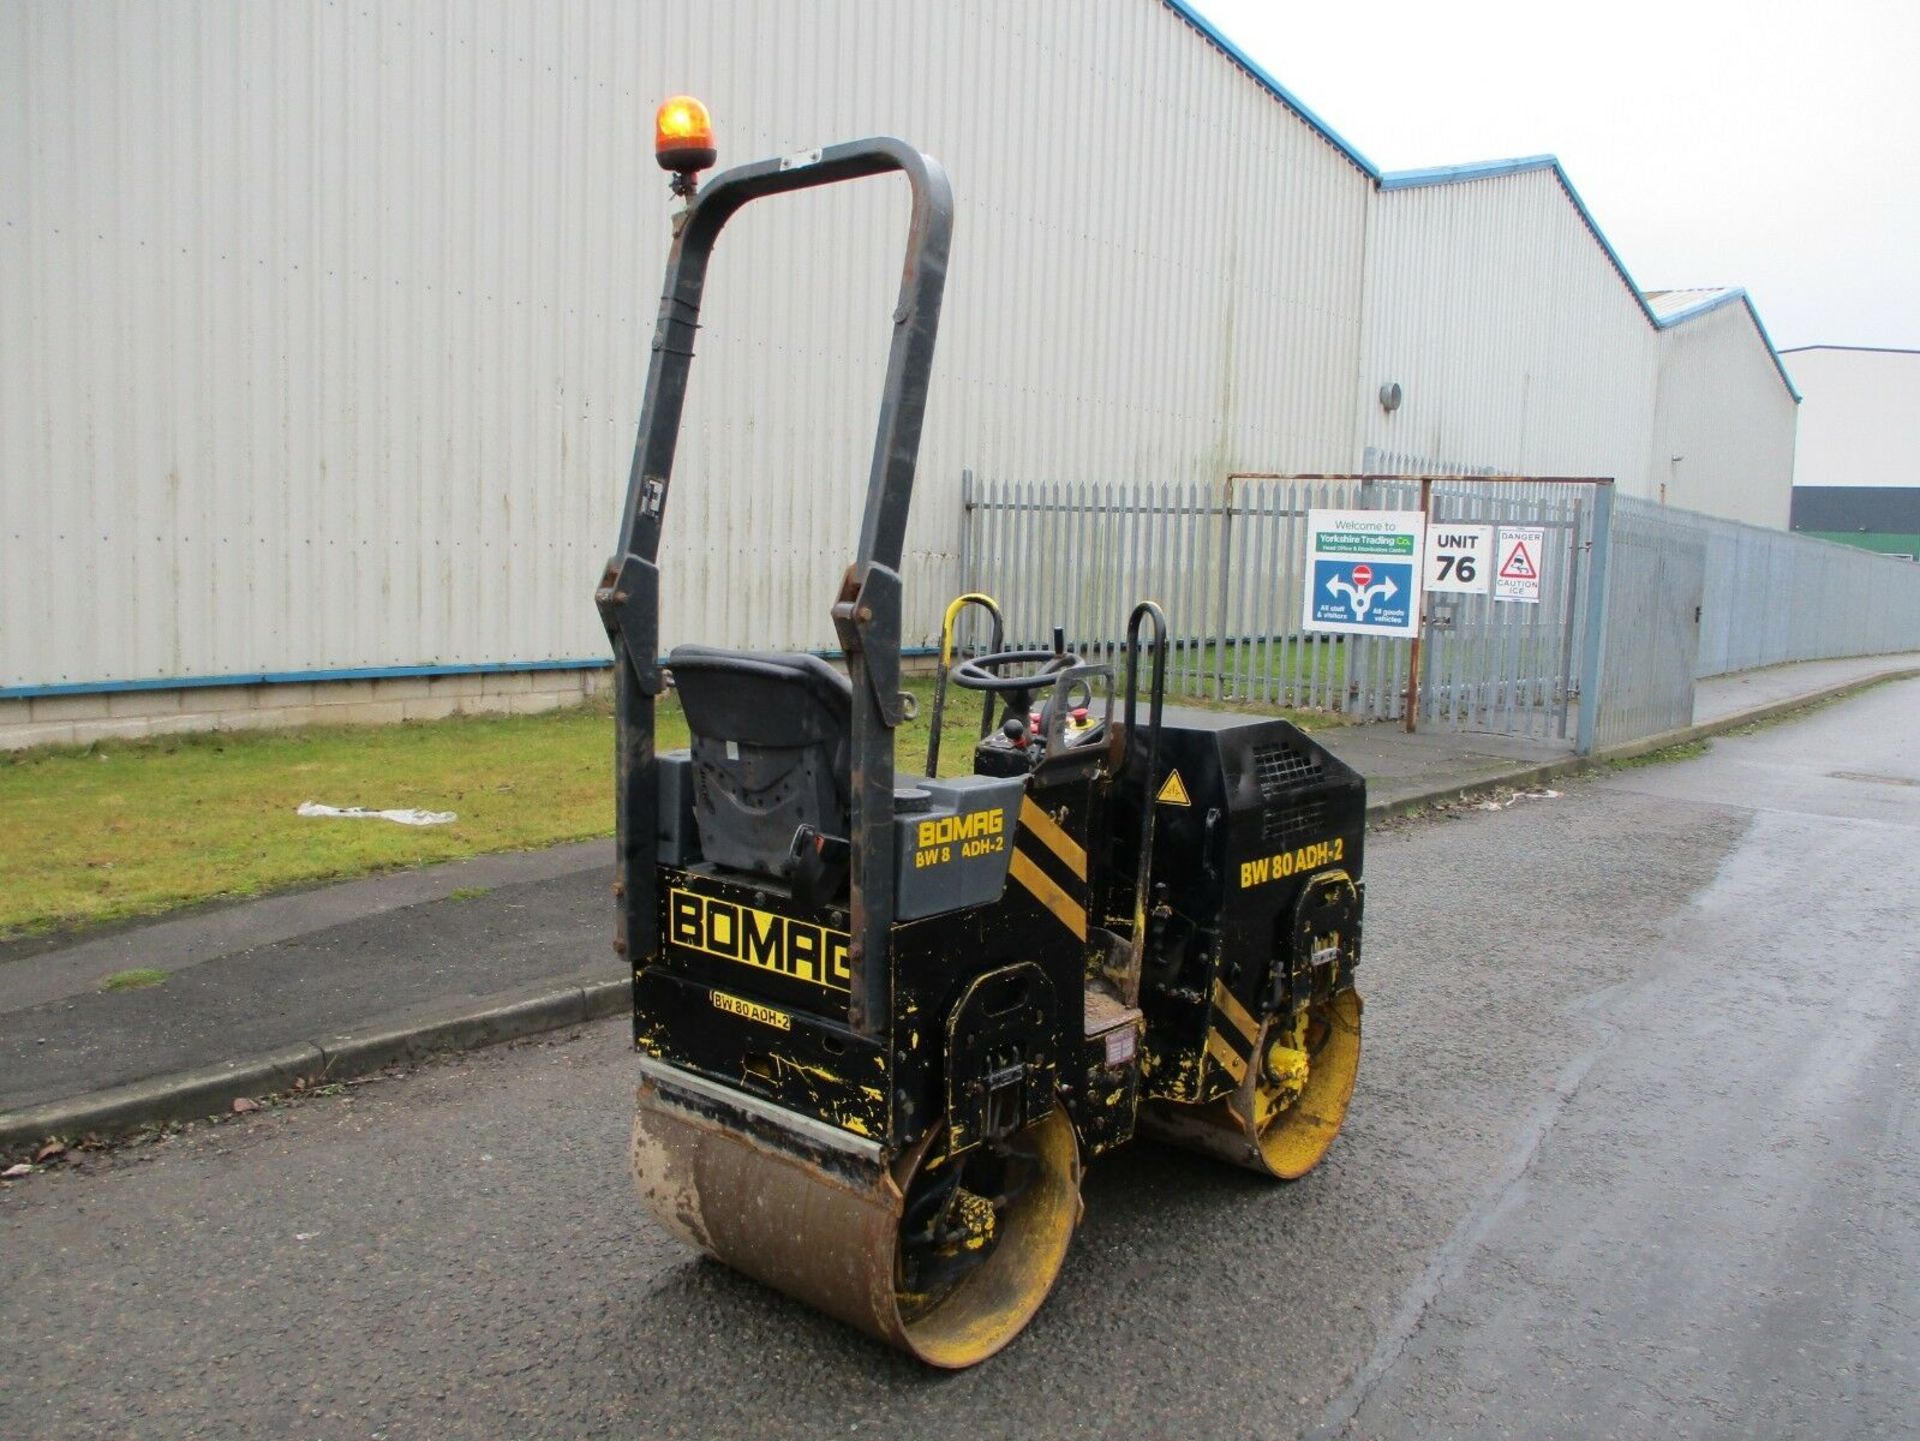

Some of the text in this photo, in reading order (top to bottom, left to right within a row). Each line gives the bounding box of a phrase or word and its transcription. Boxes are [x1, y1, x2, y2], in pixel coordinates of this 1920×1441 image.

[1335, 520, 1396, 531] Welcome to
[1320, 534, 1360, 544] Yorkshire
[1362, 536, 1395, 546] Trading
[1438, 534, 1478, 549] UNIT
[1502, 532, 1540, 541] DANGER
[1437, 556, 1476, 583] 76
[1497, 580, 1538, 588] CAUTION
[1374, 616, 1402, 624] vehicles
[1383, 609, 1404, 617] goods
[919, 808, 1003, 848] BOMAG
[915, 848, 939, 869] BW
[962, 836, 1004, 857] ADH-2
[1241, 837, 1344, 889] BW 80 ADH-2
[674, 893, 851, 990] BOMAG
[715, 994, 790, 1029] BW 80 ADH-2
